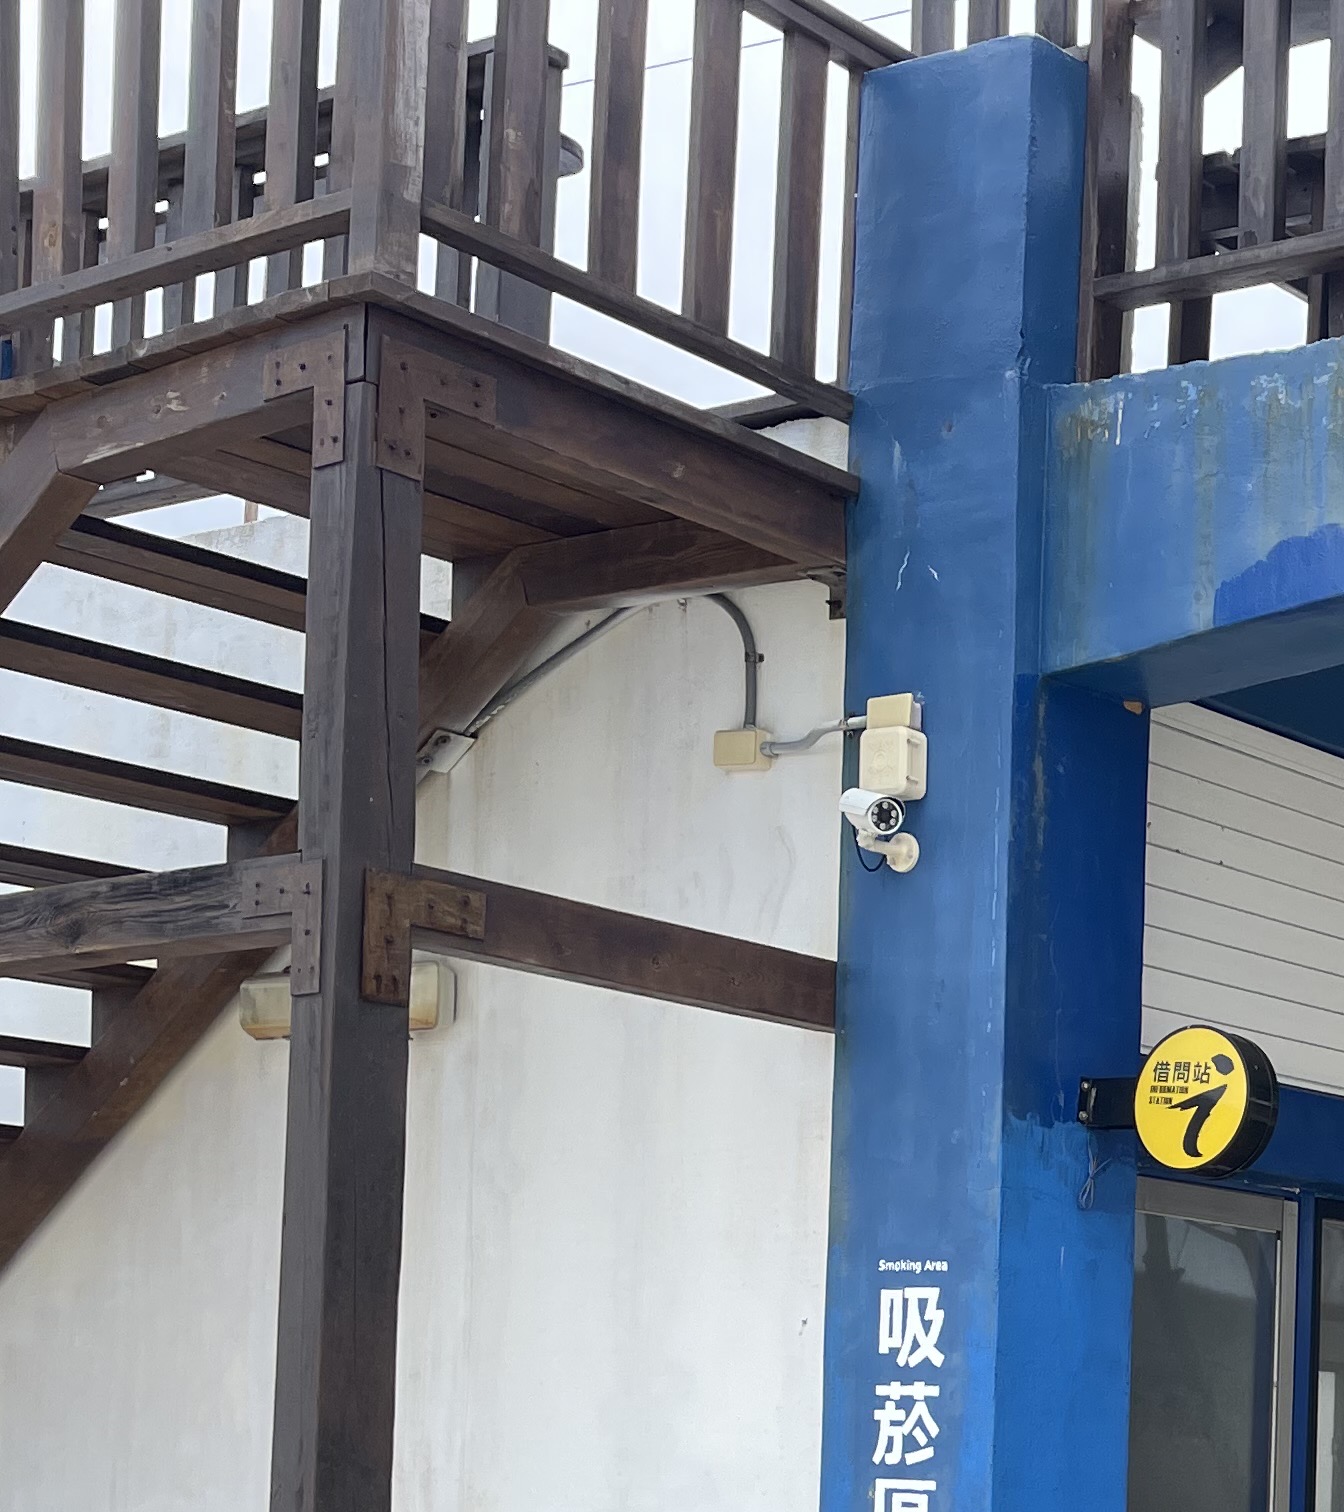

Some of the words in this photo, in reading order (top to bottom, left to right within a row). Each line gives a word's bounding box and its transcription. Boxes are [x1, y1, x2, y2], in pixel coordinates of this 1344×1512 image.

[1153, 1061, 1211, 1084] 借問站
[878, 1259, 922, 1274] Smoking
[924, 1259, 948, 1271] Area
